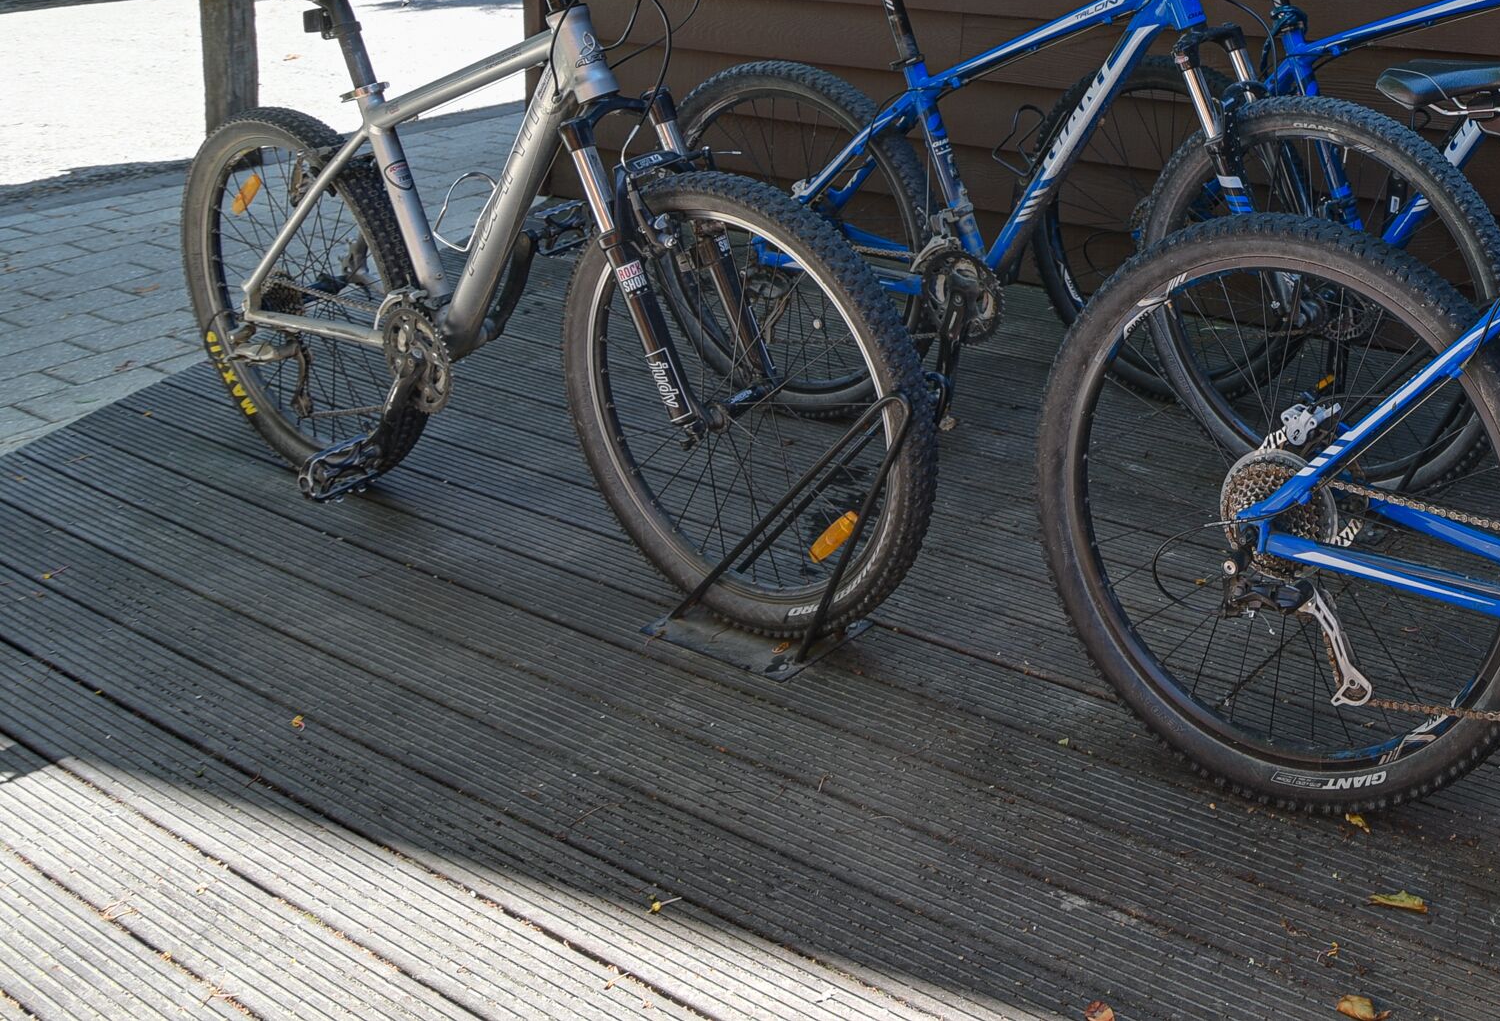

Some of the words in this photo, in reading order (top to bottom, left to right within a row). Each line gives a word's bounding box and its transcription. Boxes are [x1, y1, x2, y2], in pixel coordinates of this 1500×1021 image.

[1043, 53, 1112, 170] GIANT
[1292, 121, 1339, 133] GIANT
[617, 261, 643, 281] ROCK
[622, 274, 648, 294] SHOX
[646, 360, 680, 409] judy
[1321, 770, 1387, 791] GIANT
